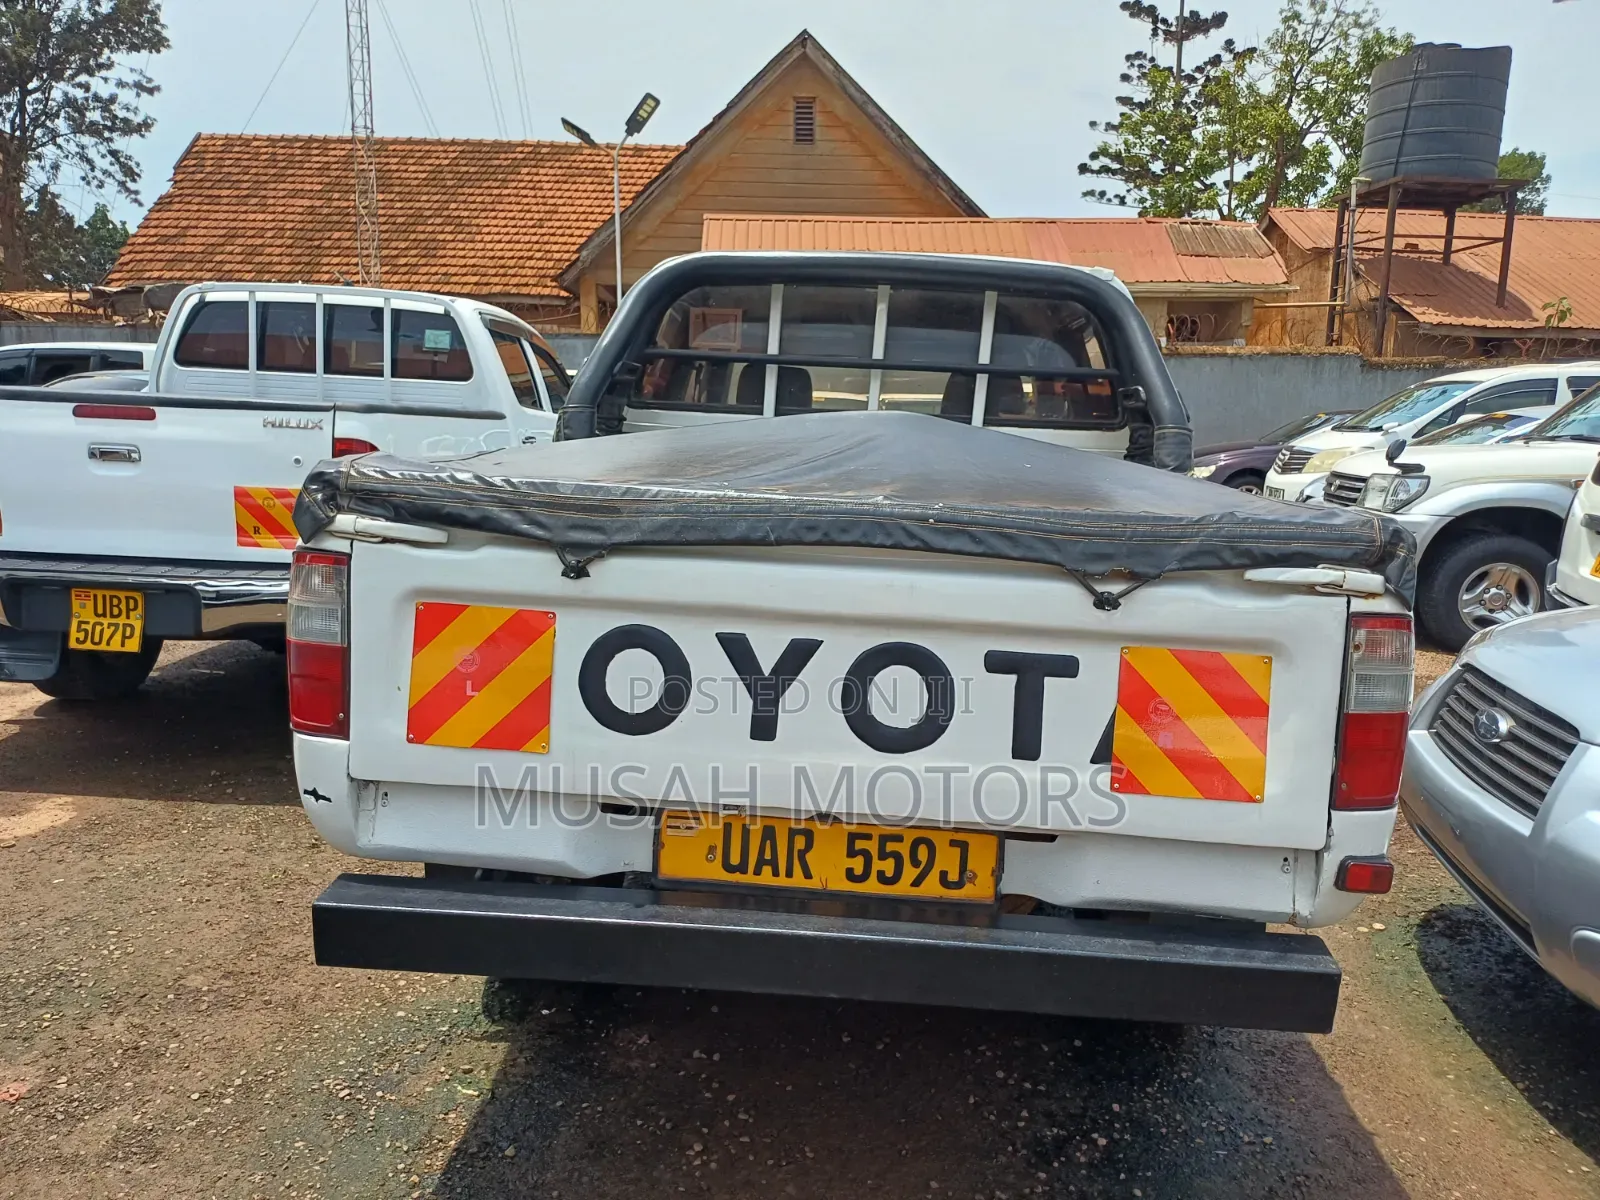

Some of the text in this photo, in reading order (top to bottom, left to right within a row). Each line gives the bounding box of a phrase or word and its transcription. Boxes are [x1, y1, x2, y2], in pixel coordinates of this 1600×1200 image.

[262, 416, 324, 430] HILUX
[252, 525, 262, 536] R
[93, 593, 139, 620] UBP
[75, 620, 136, 648] 507P
[466, 680, 479, 696] L
[578, 623, 1117, 765] OYOT
[721, 822, 970, 890] UAR 559J
